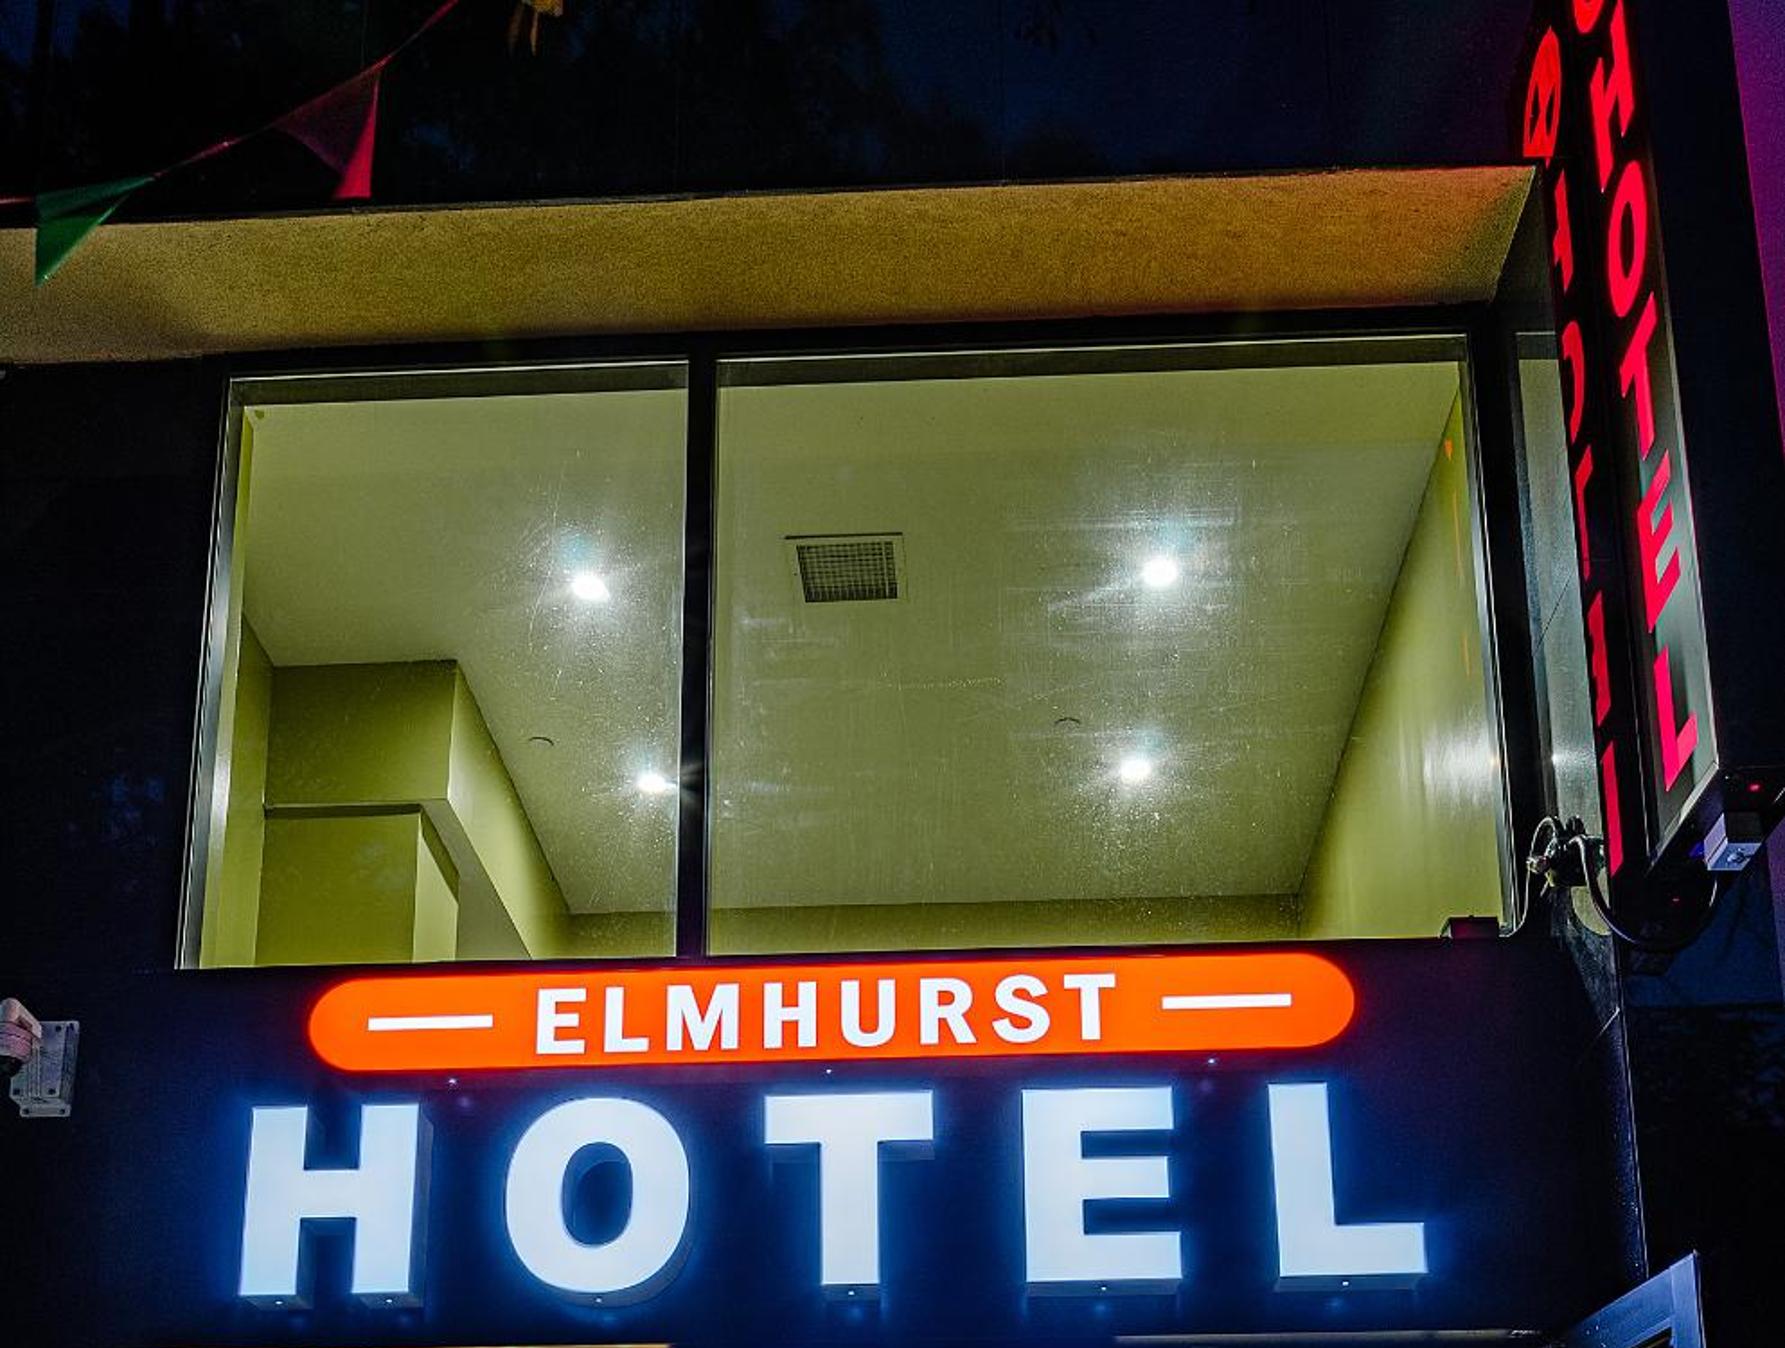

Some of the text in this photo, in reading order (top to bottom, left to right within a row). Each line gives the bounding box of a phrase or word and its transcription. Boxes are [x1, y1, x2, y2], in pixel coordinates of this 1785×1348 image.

[1591, 0, 1698, 792] HOTEL
[534, 973, 1118, 1056] ELMHURST
[238, 1081, 1428, 1298] HOTEL
